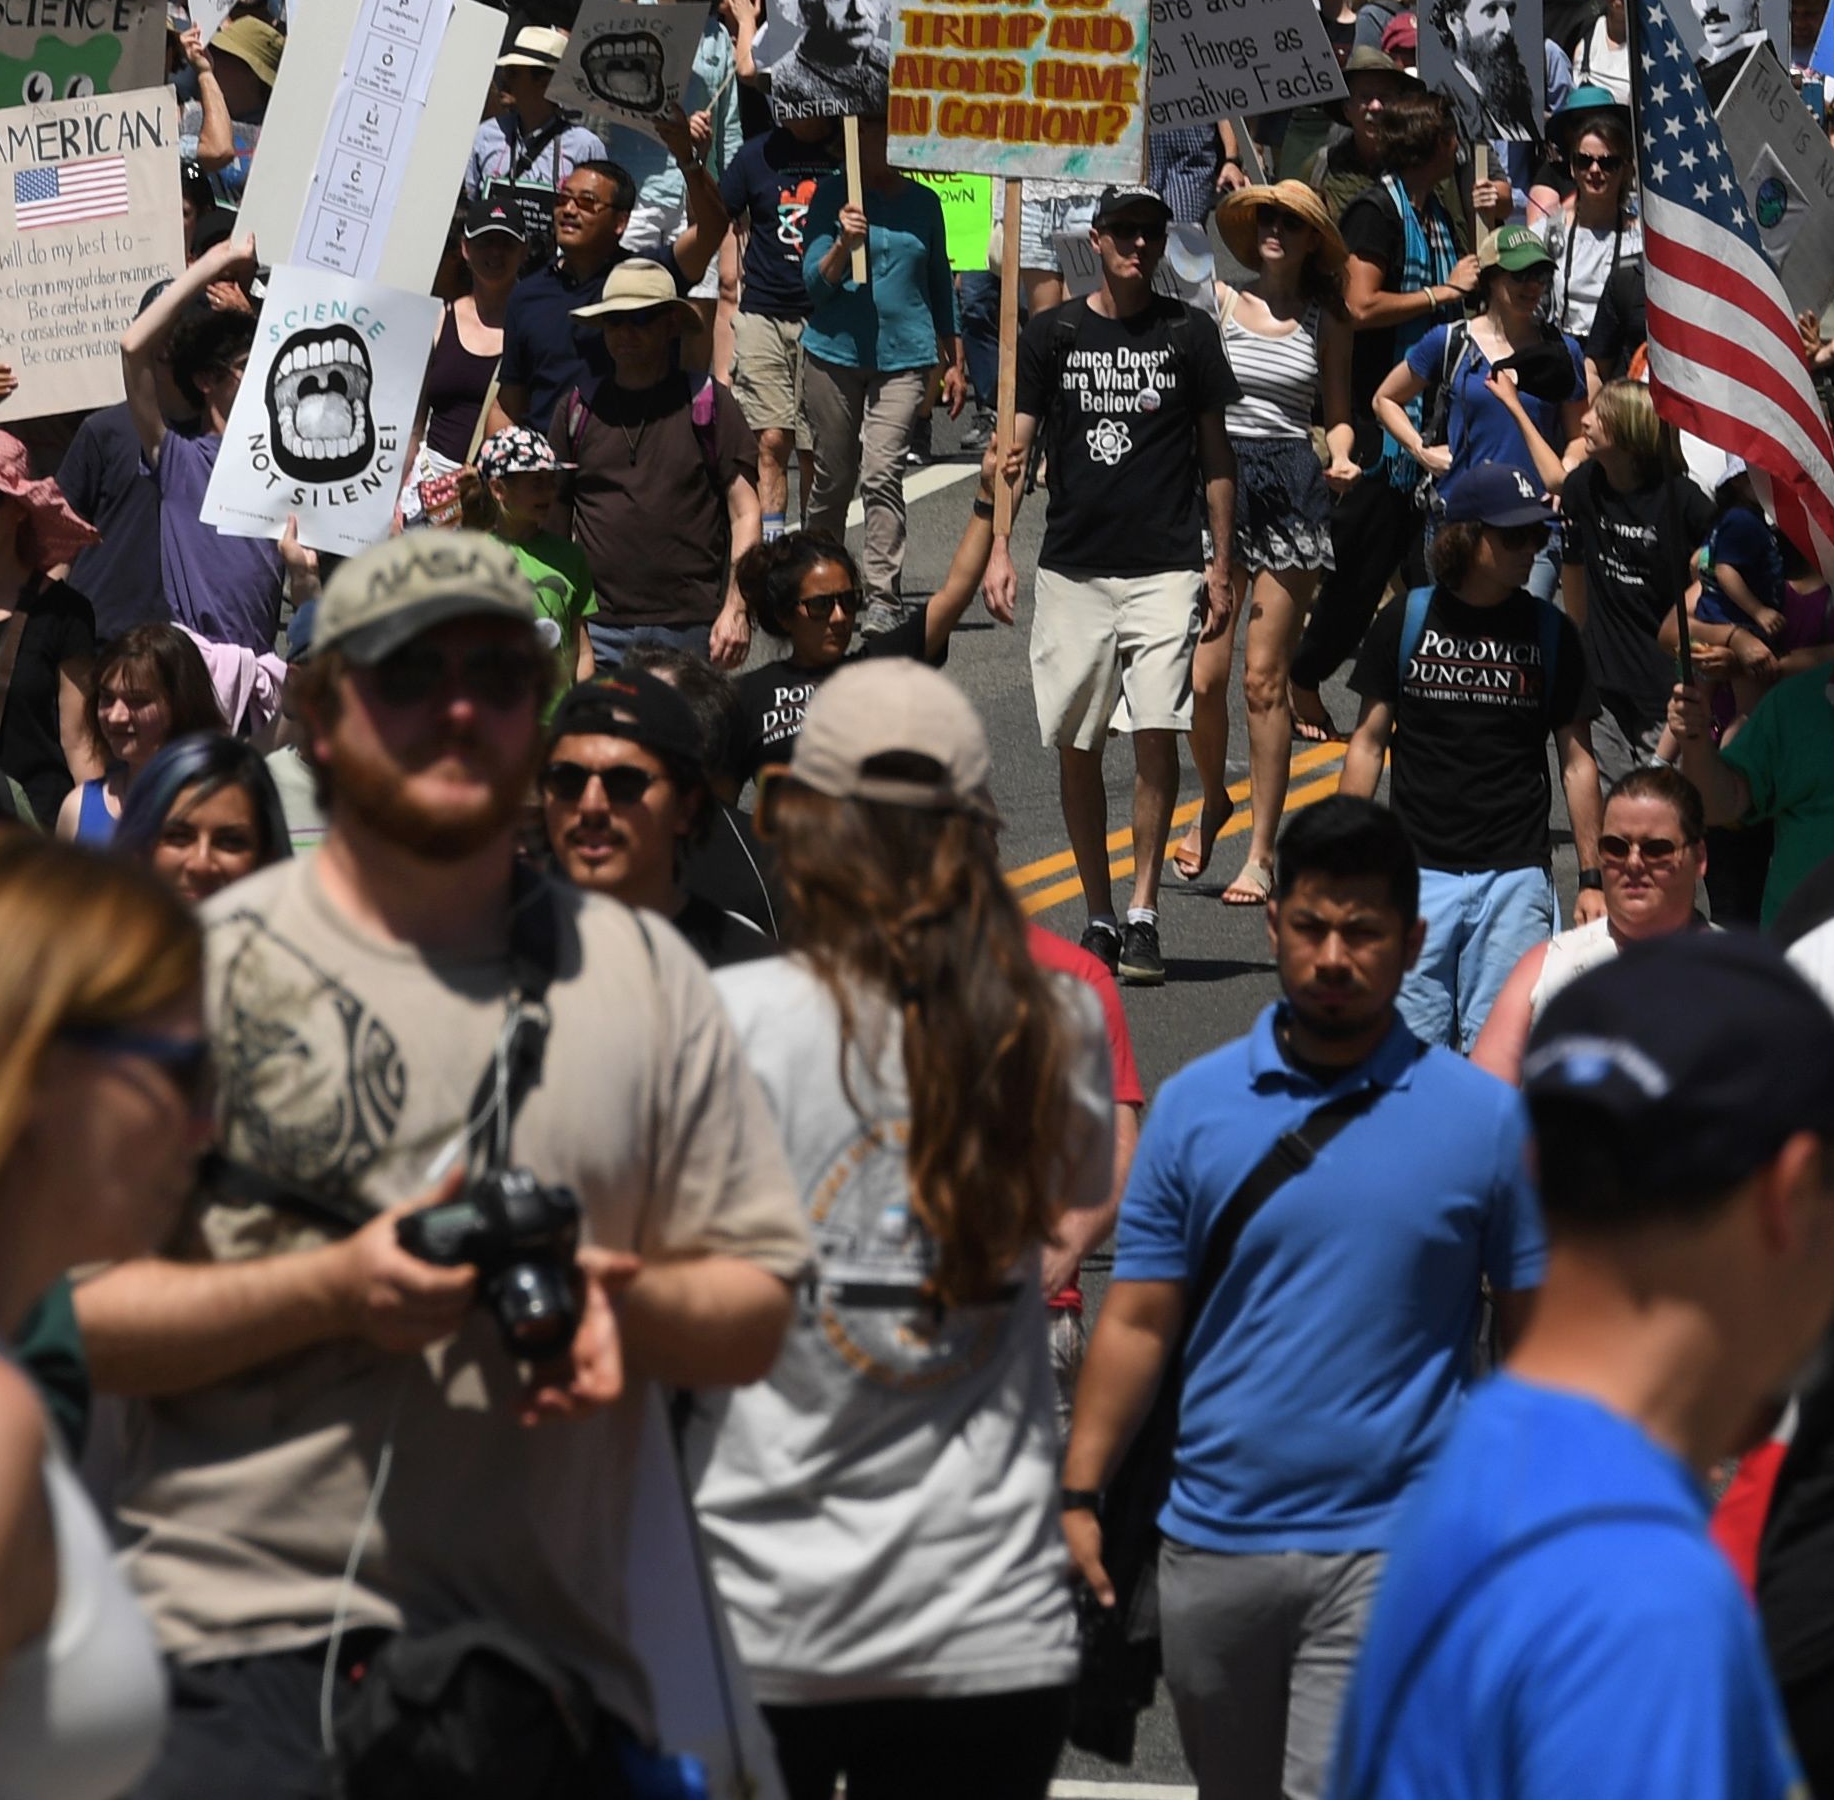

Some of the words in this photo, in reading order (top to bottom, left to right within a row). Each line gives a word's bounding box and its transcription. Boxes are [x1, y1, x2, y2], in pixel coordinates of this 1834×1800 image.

[900, 10, 1045, 50] TRUMP
[1046, 16, 1135, 53] AND
[892, 55, 1026, 95] ATOMS
[1033, 60, 1138, 103] HAVE
[890, 95, 932, 135] IN
[937, 99, 1131, 146] COMMON?
[268, 299, 387, 344] SCIENCE
[248, 432, 282, 490] NOT
[289, 423, 399, 508] SILENCE!
[1419, 629, 1541, 666] POPOVICH
